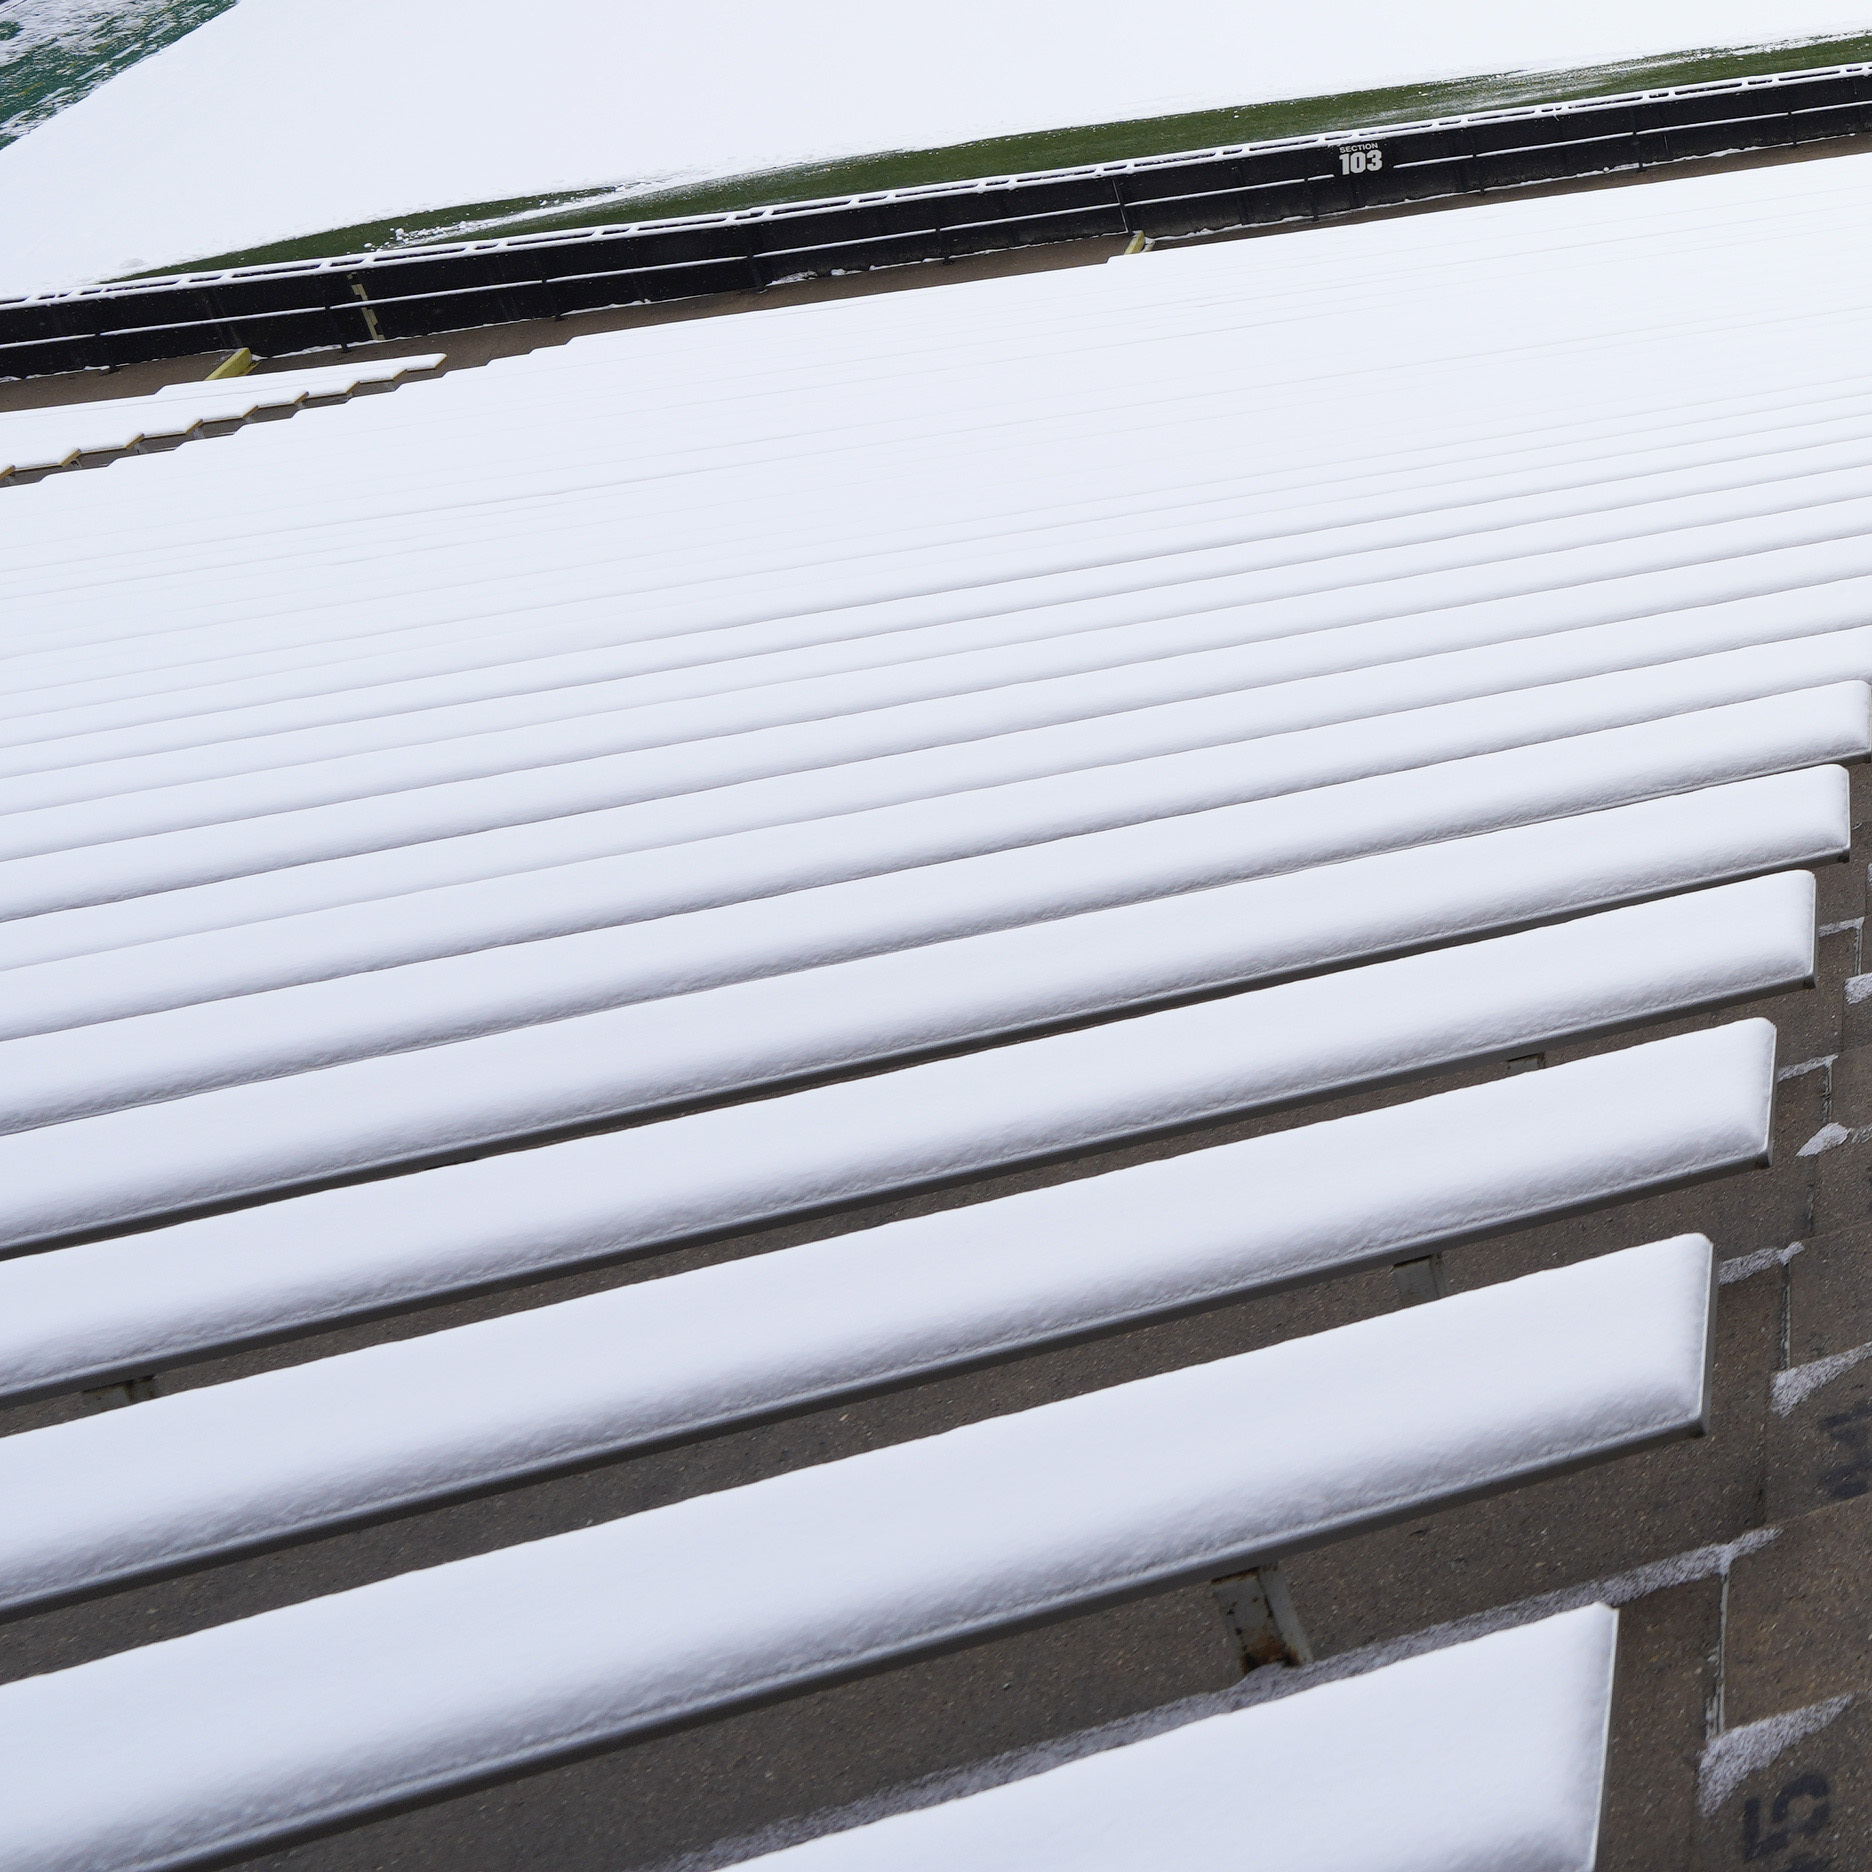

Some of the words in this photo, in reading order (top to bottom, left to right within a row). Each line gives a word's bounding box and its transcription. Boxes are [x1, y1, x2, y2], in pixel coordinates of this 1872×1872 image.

[1339, 142, 1379, 154] SECTION
[1339, 149, 1383, 176] 103
[1741, 1772, 1833, 1872] 5
